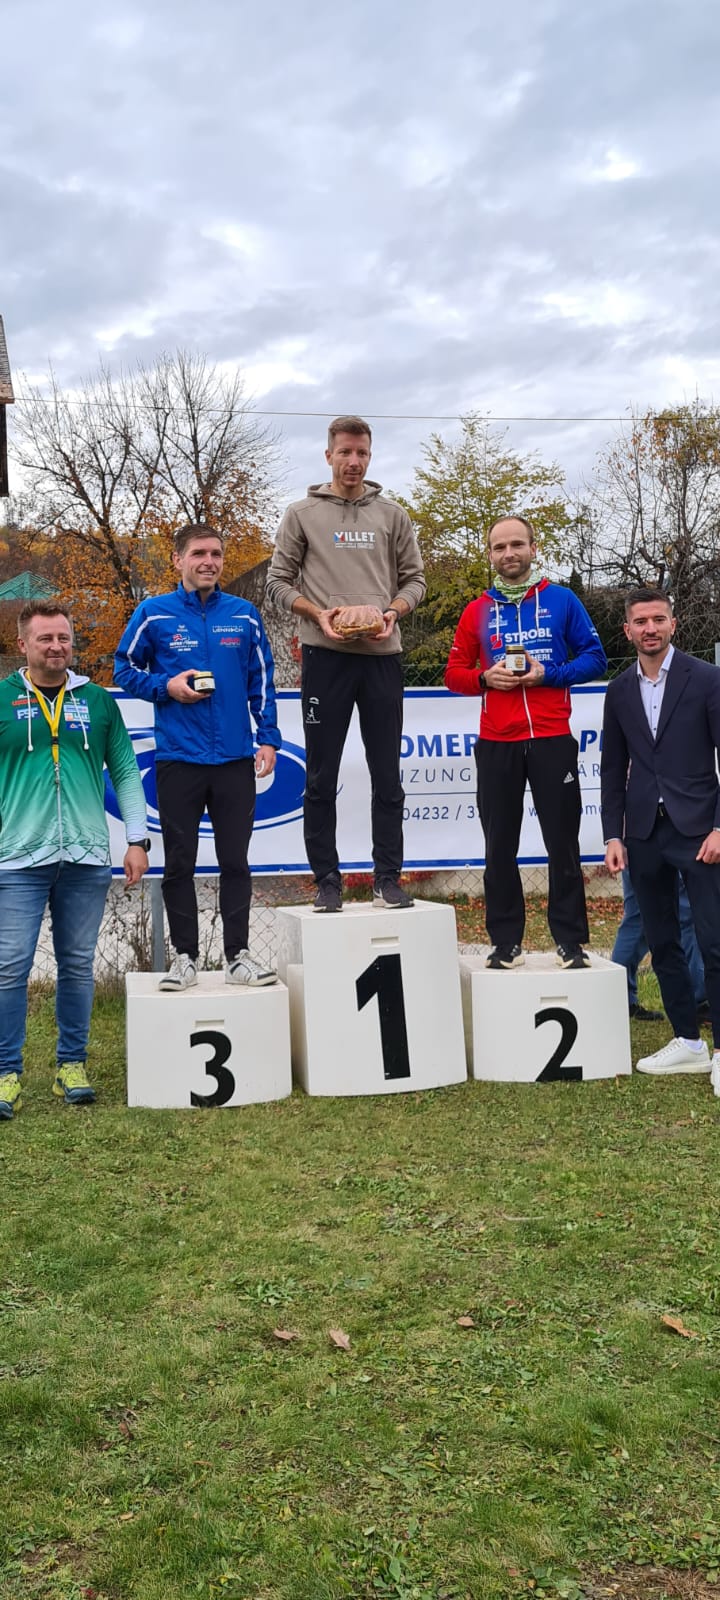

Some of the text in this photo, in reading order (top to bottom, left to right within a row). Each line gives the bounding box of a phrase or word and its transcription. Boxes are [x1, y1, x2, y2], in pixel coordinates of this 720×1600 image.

[504, 628, 553, 643] STROBL
[402, 806, 450, 821] 04232
[355, 953, 410, 1080] 1
[534, 1006, 583, 1082] 2
[189, 1030, 236, 1108] 3
